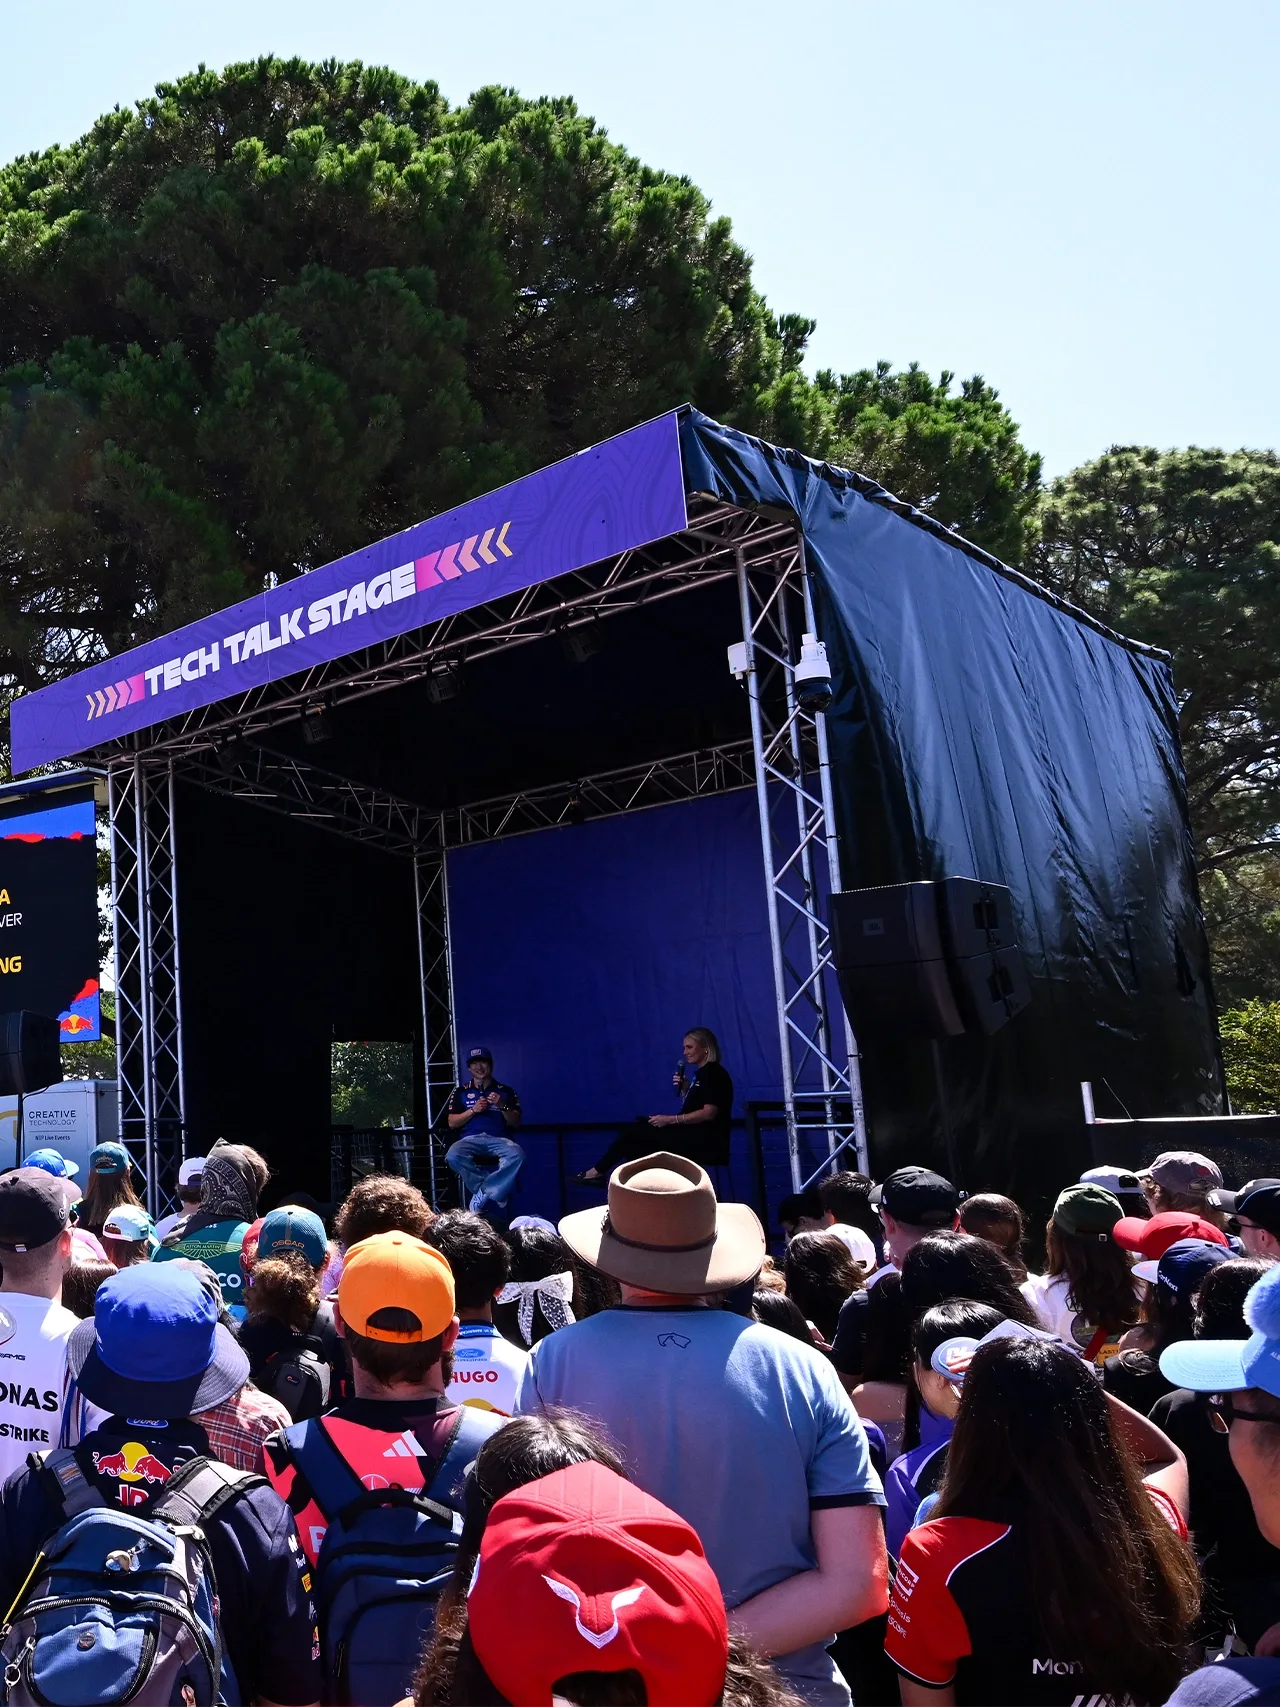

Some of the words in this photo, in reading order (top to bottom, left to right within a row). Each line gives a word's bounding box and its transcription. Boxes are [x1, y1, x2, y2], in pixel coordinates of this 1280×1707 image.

[145, 642, 220, 696] TECH
[223, 607, 305, 665] TALK
[307, 561, 416, 635] STAGE
[28, 1109, 77, 1119] CREATIVE
[271, 1239, 305, 1249] OSCAR
[2, 1352, 26, 1361] AMG
[460, 1348, 480, 1358] Ford
[451, 1370, 499, 1384] HUGO
